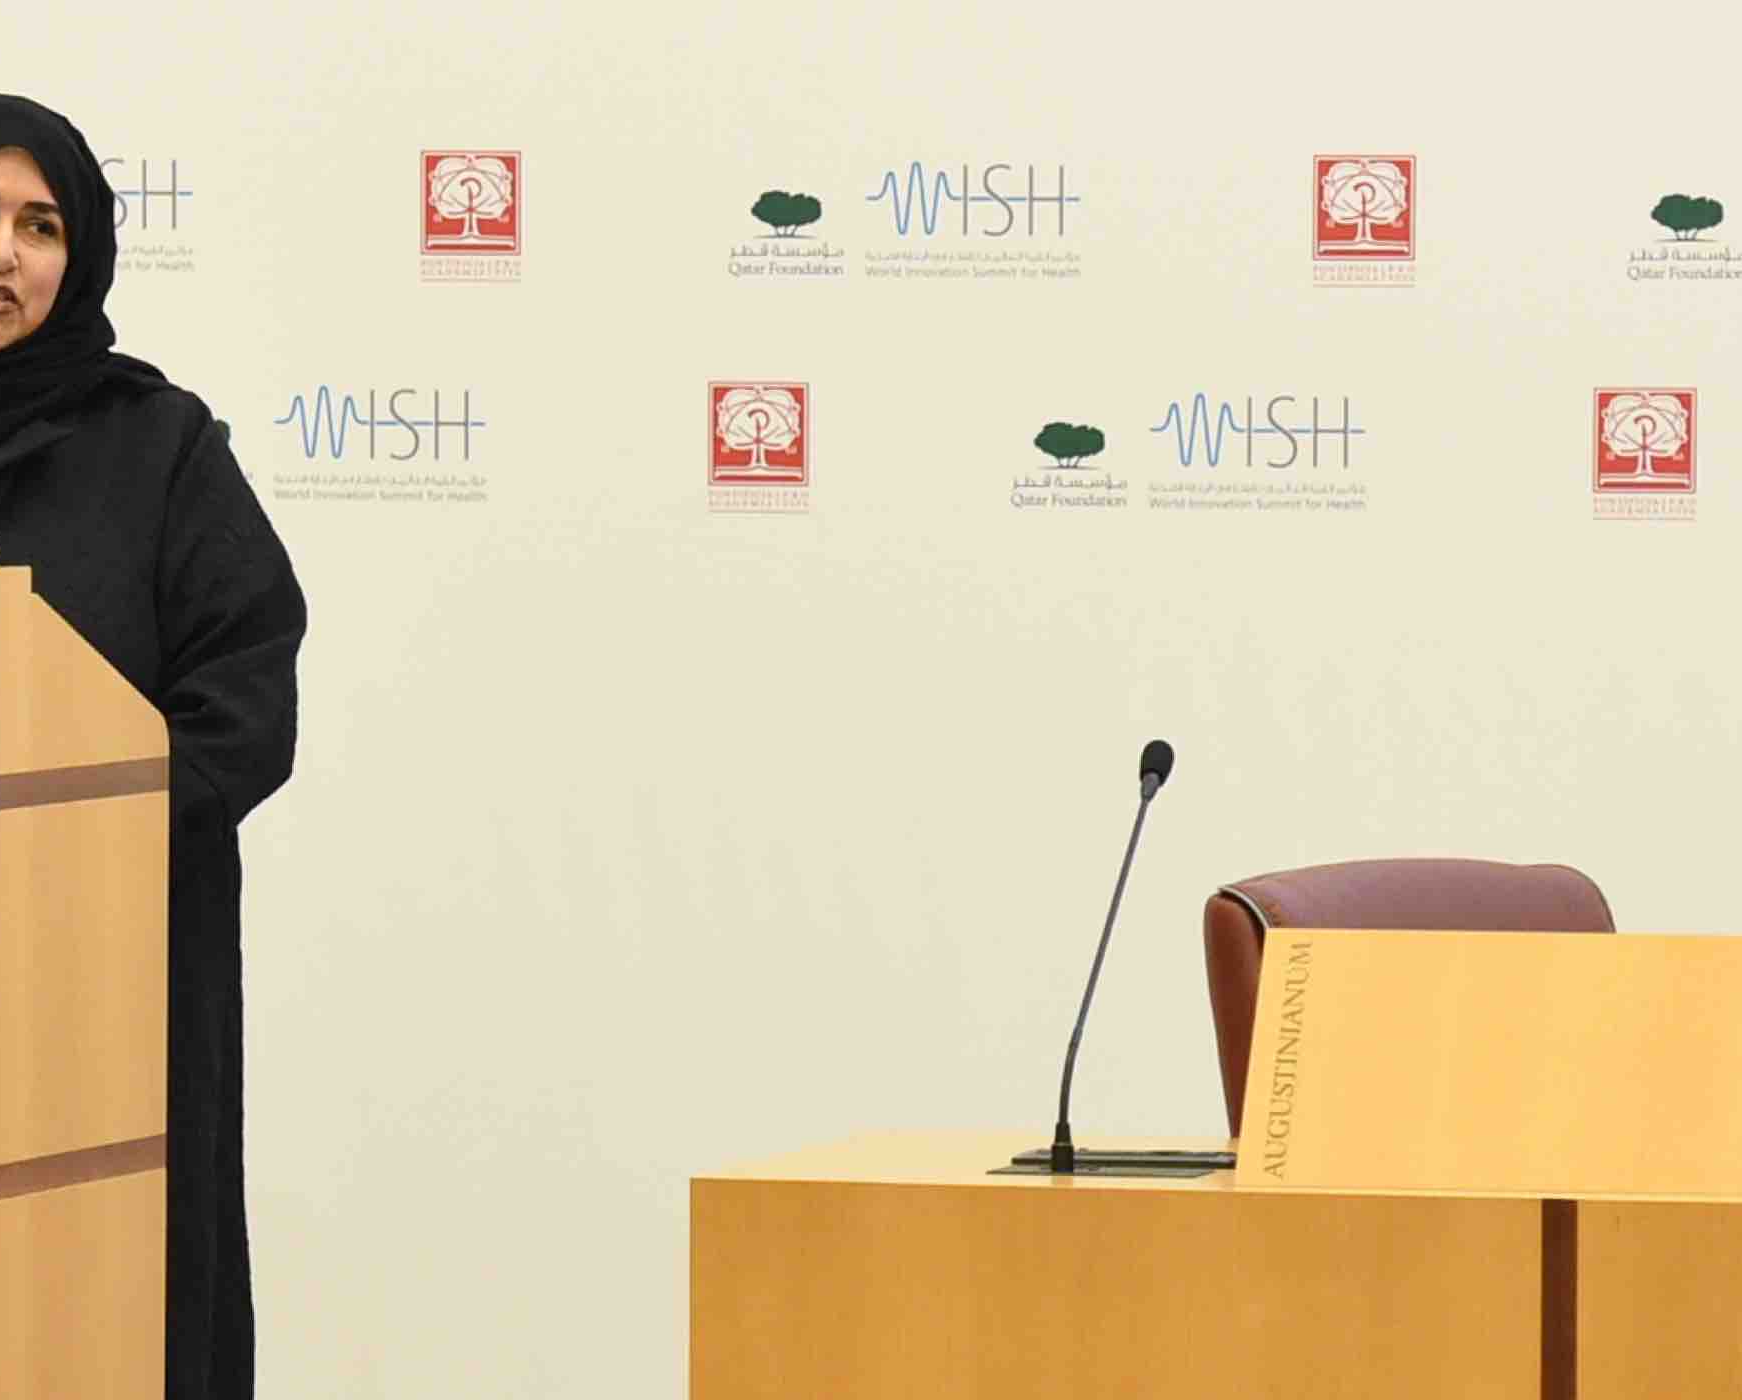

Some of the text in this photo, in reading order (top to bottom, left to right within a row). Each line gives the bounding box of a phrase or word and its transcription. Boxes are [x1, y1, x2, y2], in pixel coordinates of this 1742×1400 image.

[865, 161, 1081, 237] WISH
[728, 261, 843, 279] Qatar Foundation
[1626, 265, 1664, 283] Qatar
[274, 385, 486, 461] WISH
[1149, 392, 1366, 469] WISH
[1010, 492, 1127, 510] Qatar Foundation
[1263, 943, 1312, 1180] AUGUSTINIANUM
